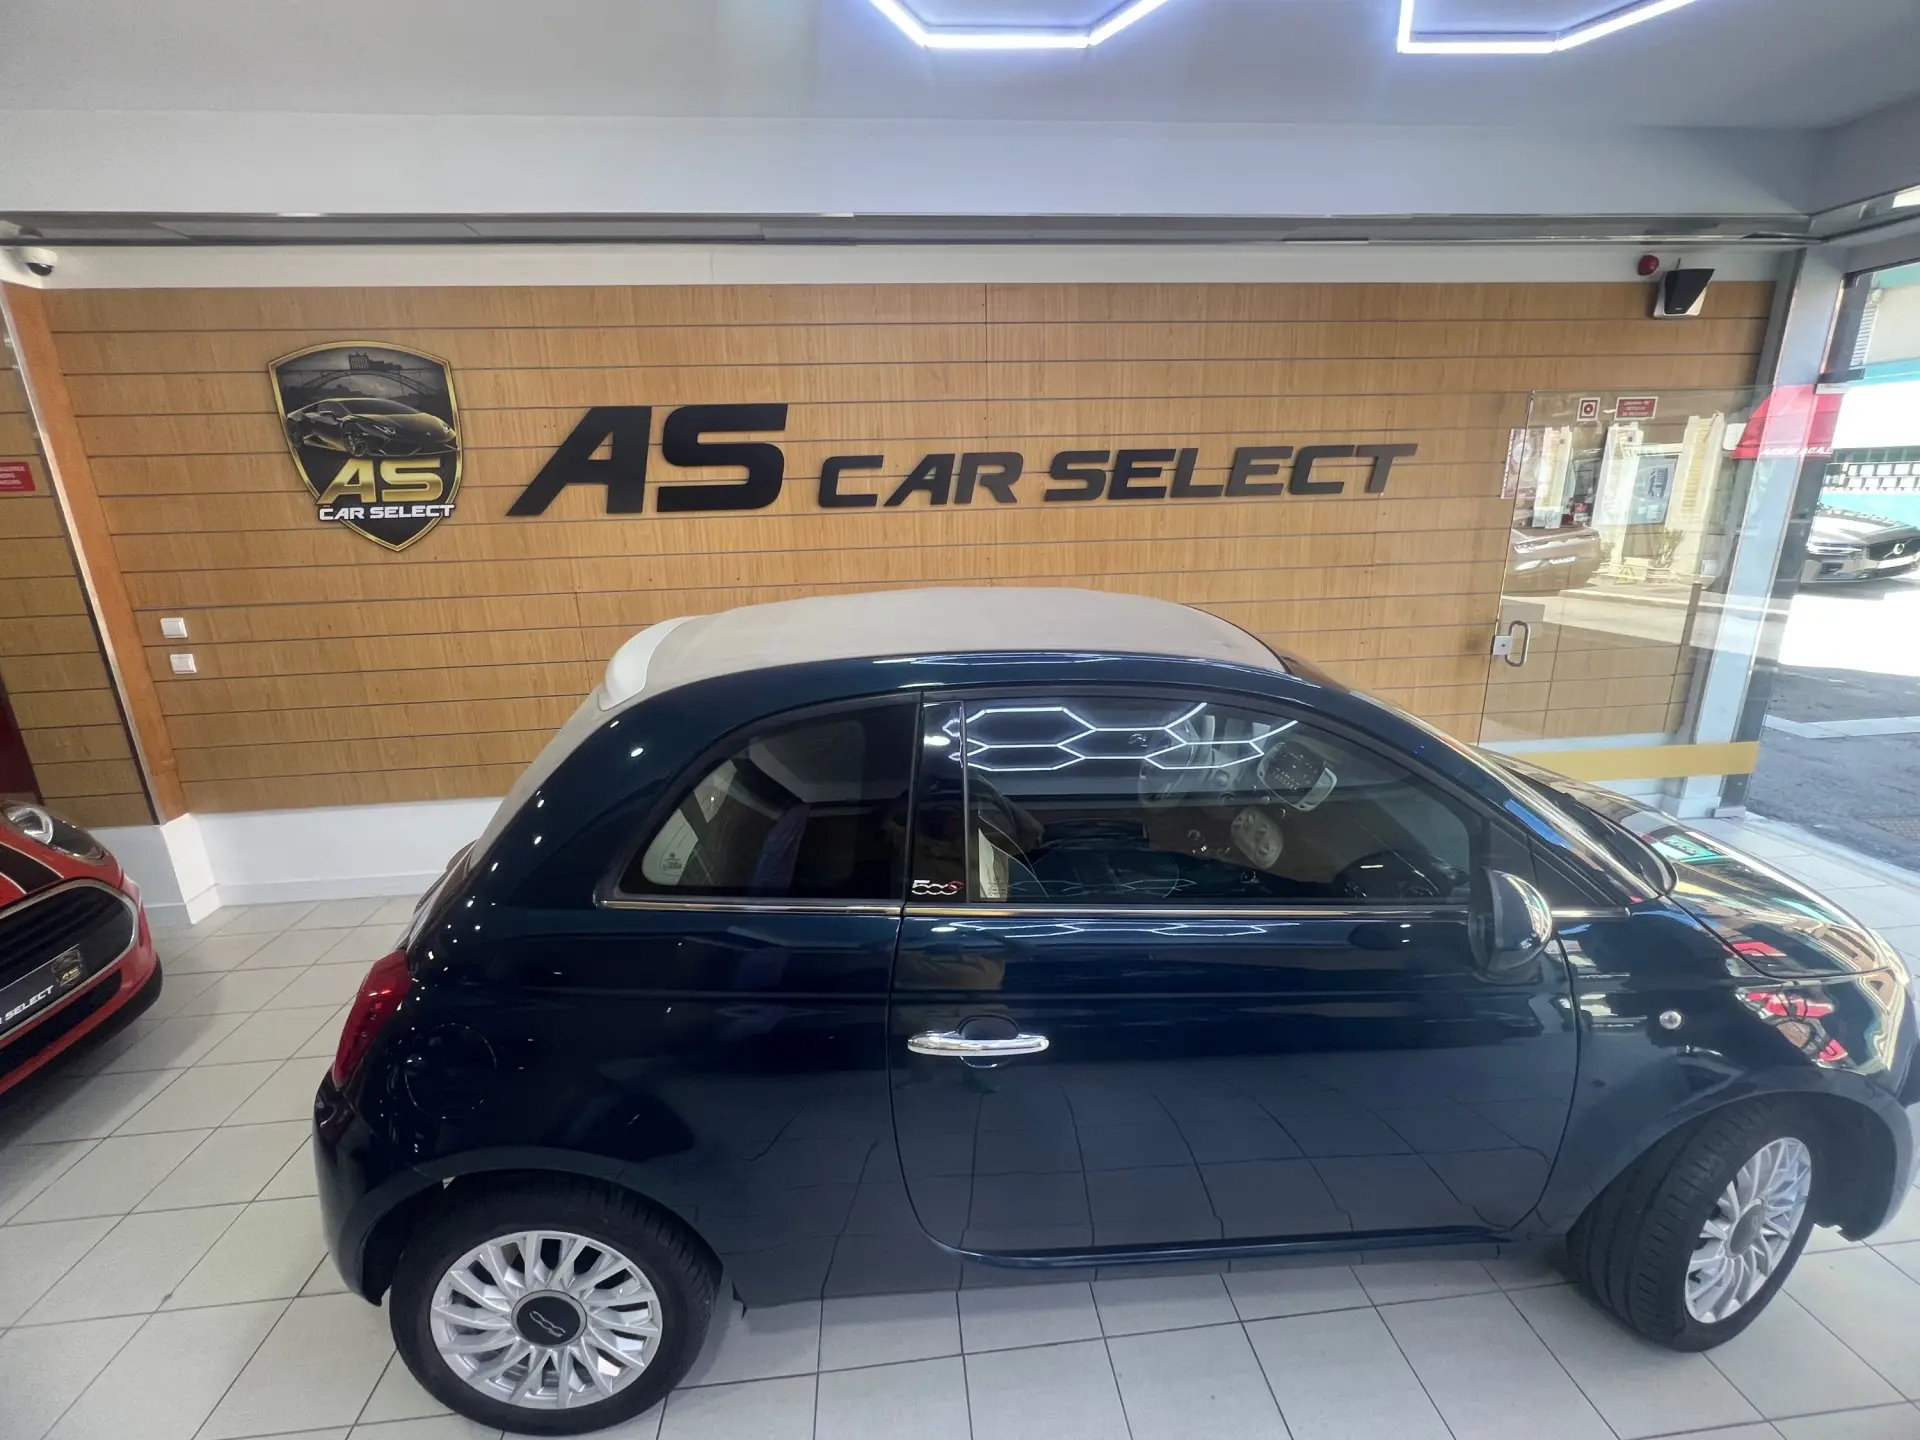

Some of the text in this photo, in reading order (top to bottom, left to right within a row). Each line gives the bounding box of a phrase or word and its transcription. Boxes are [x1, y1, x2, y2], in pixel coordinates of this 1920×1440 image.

[506, 403, 1418, 516] AS CAR SELECT
[316, 458, 443, 505] AS
[319, 504, 455, 521] CAR SELECT
[5, 985, 54, 1021] SELECT
